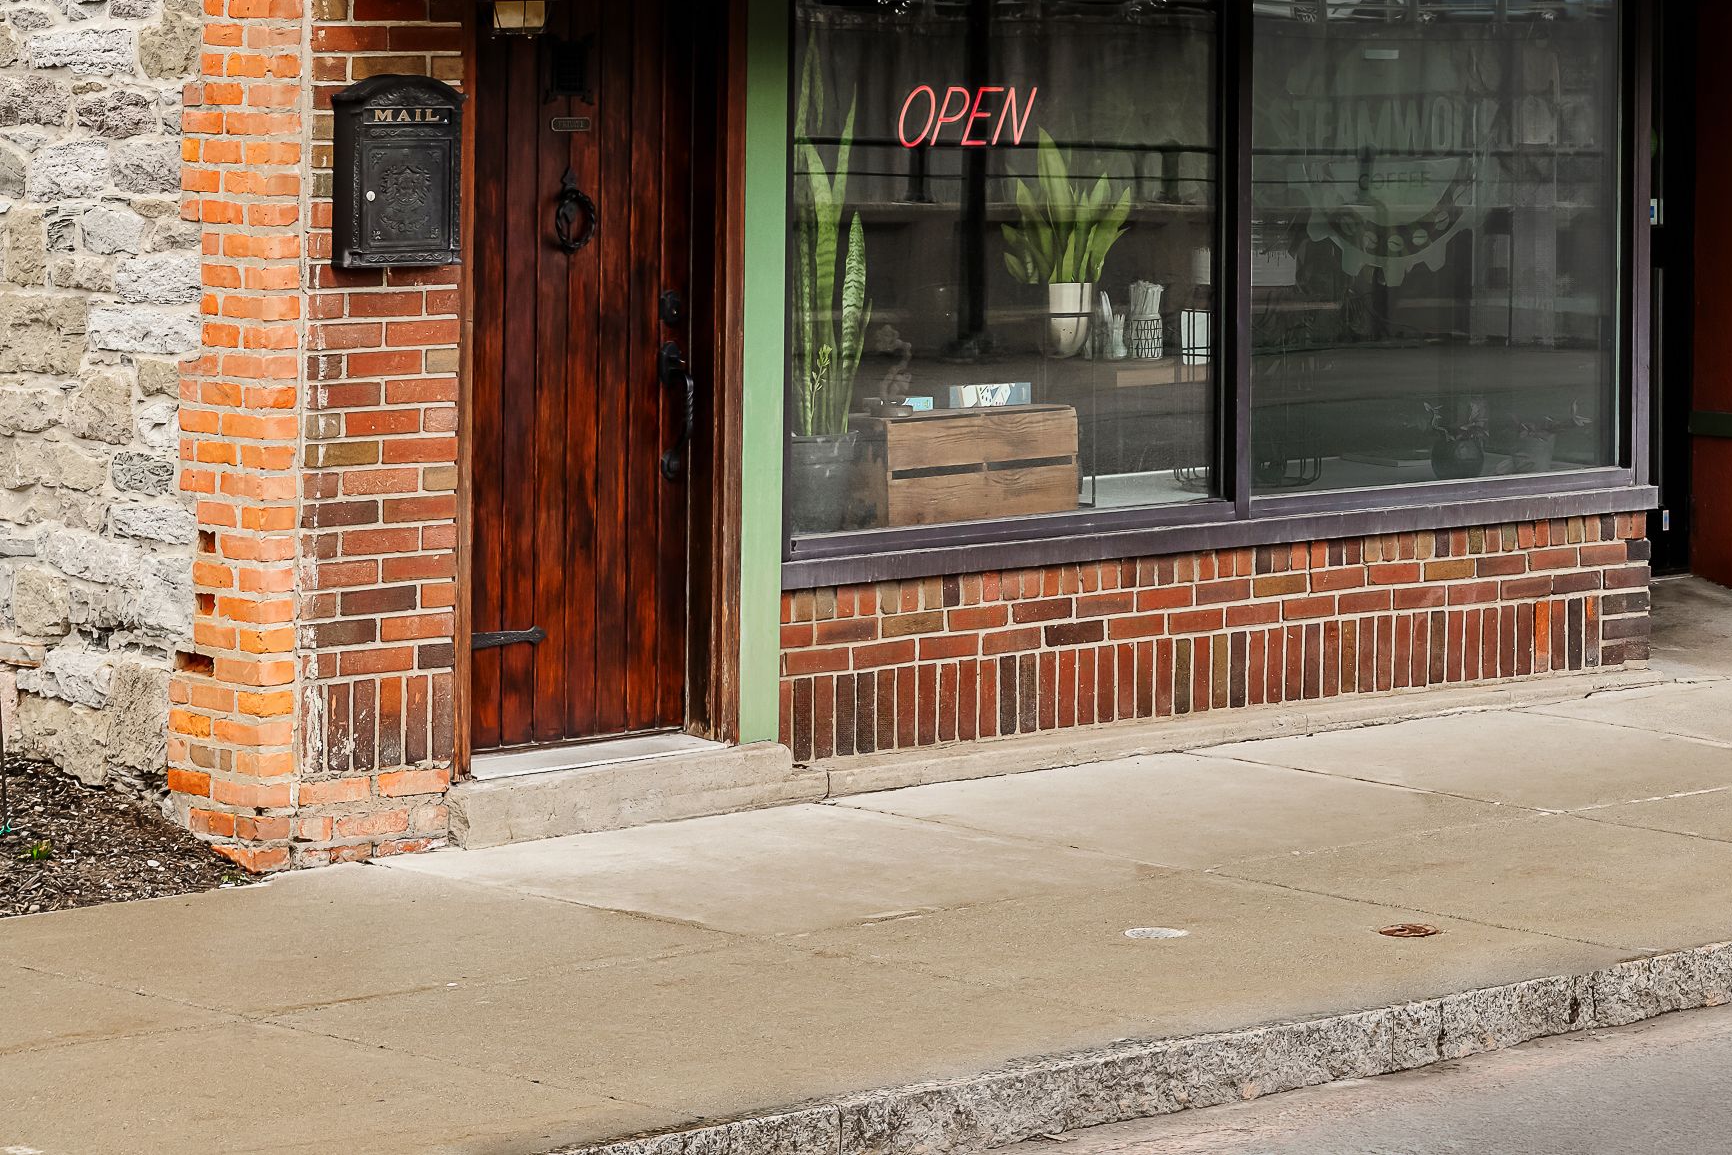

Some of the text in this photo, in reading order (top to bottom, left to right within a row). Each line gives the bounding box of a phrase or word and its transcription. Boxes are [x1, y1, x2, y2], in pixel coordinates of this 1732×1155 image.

[373, 109, 440, 122] MAIL
[898, 84, 1038, 148] OPEN
[1358, 171, 1432, 191] COFFEE
